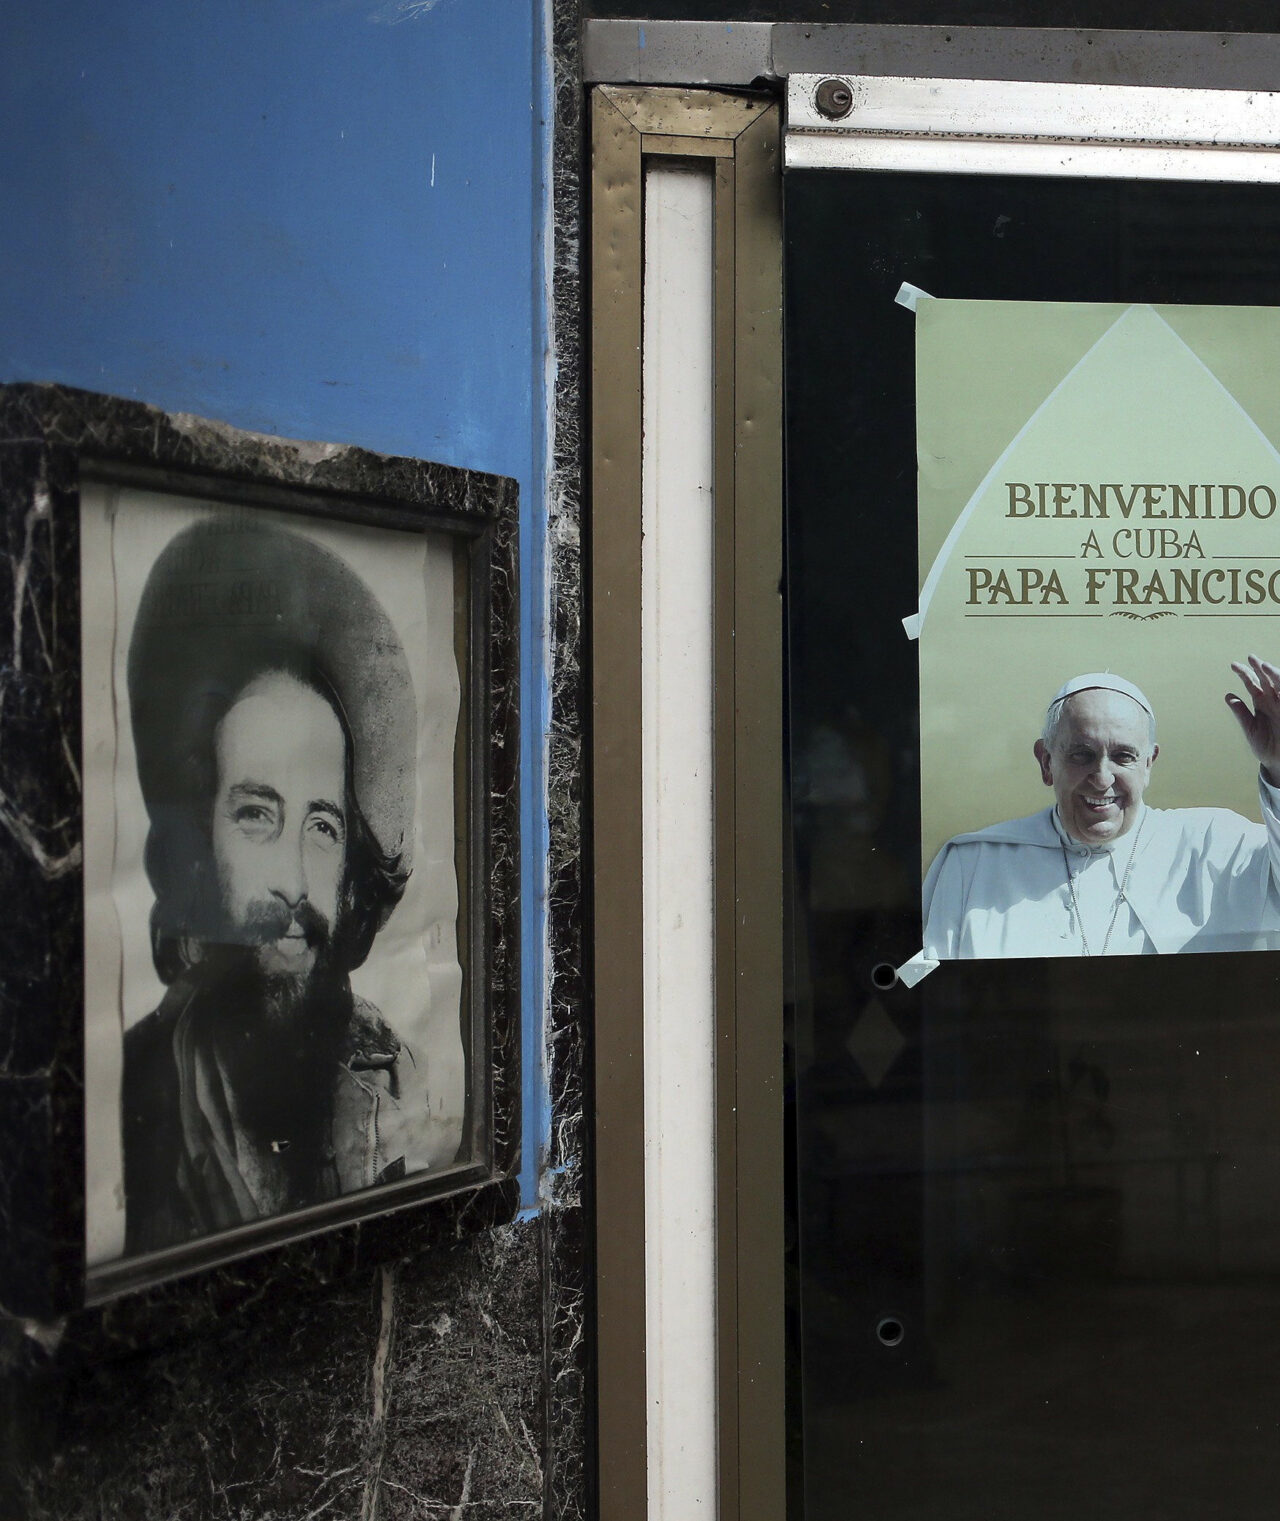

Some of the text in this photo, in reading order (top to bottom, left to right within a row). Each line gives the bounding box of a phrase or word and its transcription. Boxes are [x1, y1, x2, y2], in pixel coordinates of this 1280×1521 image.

[1004, 482, 1277, 520] BIENVENIDO
[1080, 528, 1207, 559] A CUBA
[965, 568, 1070, 605] PAPA
